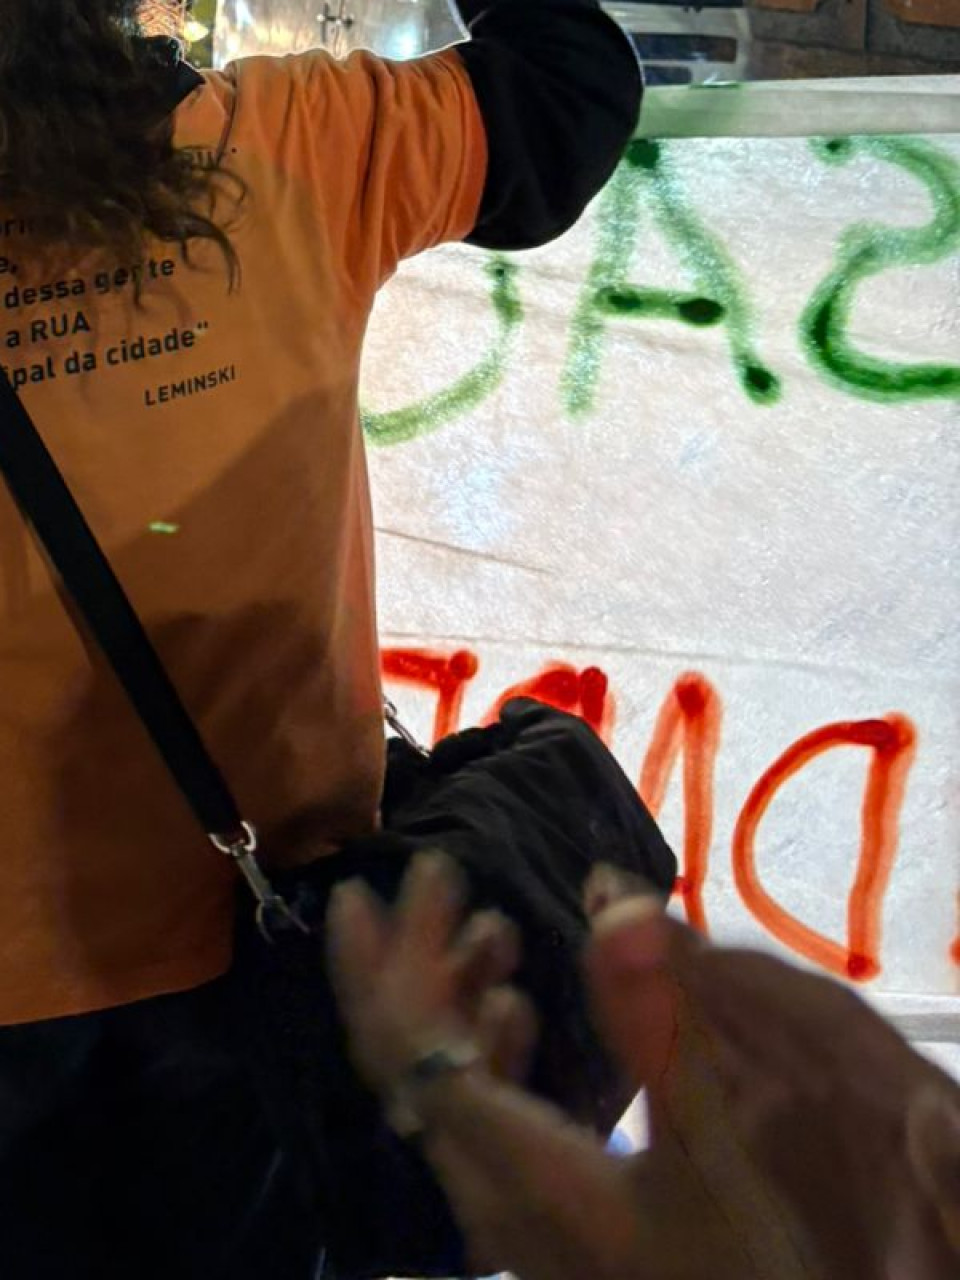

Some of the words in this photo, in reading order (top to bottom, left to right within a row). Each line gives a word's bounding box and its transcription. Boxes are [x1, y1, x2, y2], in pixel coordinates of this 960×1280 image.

[4, 278, 86, 309] dessa
[6, 330, 21, 349] a
[31, 311, 91, 343] RUA
[65, 351, 97, 375] da
[145, 365, 237, 407] LEMINSKI
